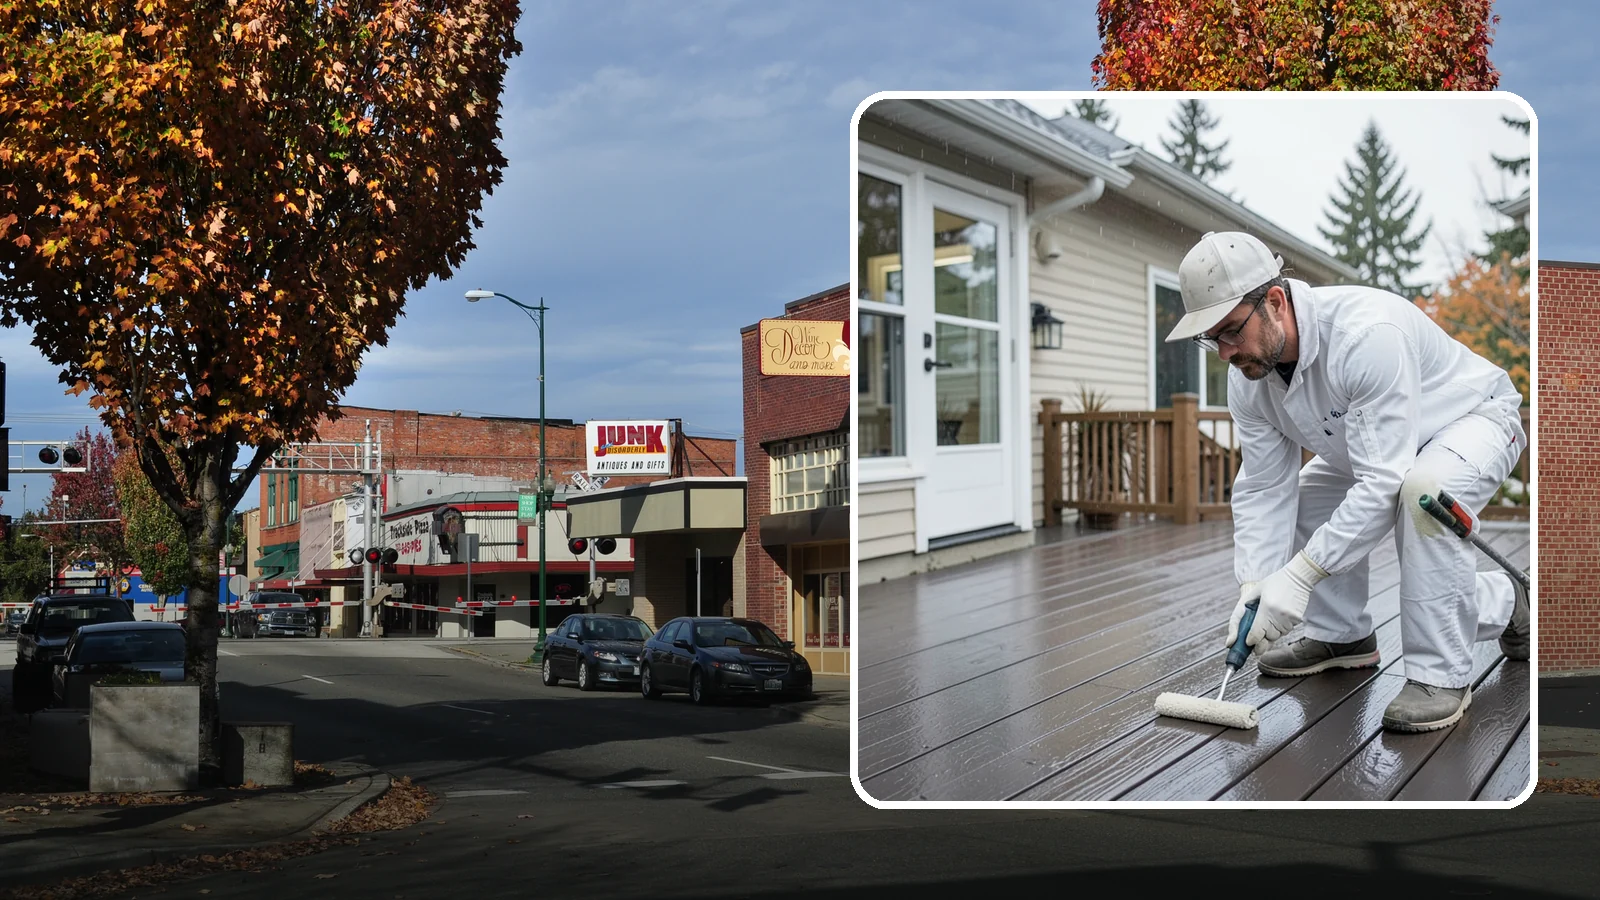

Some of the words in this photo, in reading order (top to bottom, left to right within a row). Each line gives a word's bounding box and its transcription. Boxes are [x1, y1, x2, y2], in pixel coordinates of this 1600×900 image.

[765, 327, 831, 365] Decor
[595, 425, 665, 457] JUNK
[607, 446, 646, 454] DISORDERLY
[596, 461, 628, 470] ANTIQUES
[631, 461, 644, 470] AND
[646, 460, 665, 470] GIFTS
[414, 519, 429, 534] Pizza
